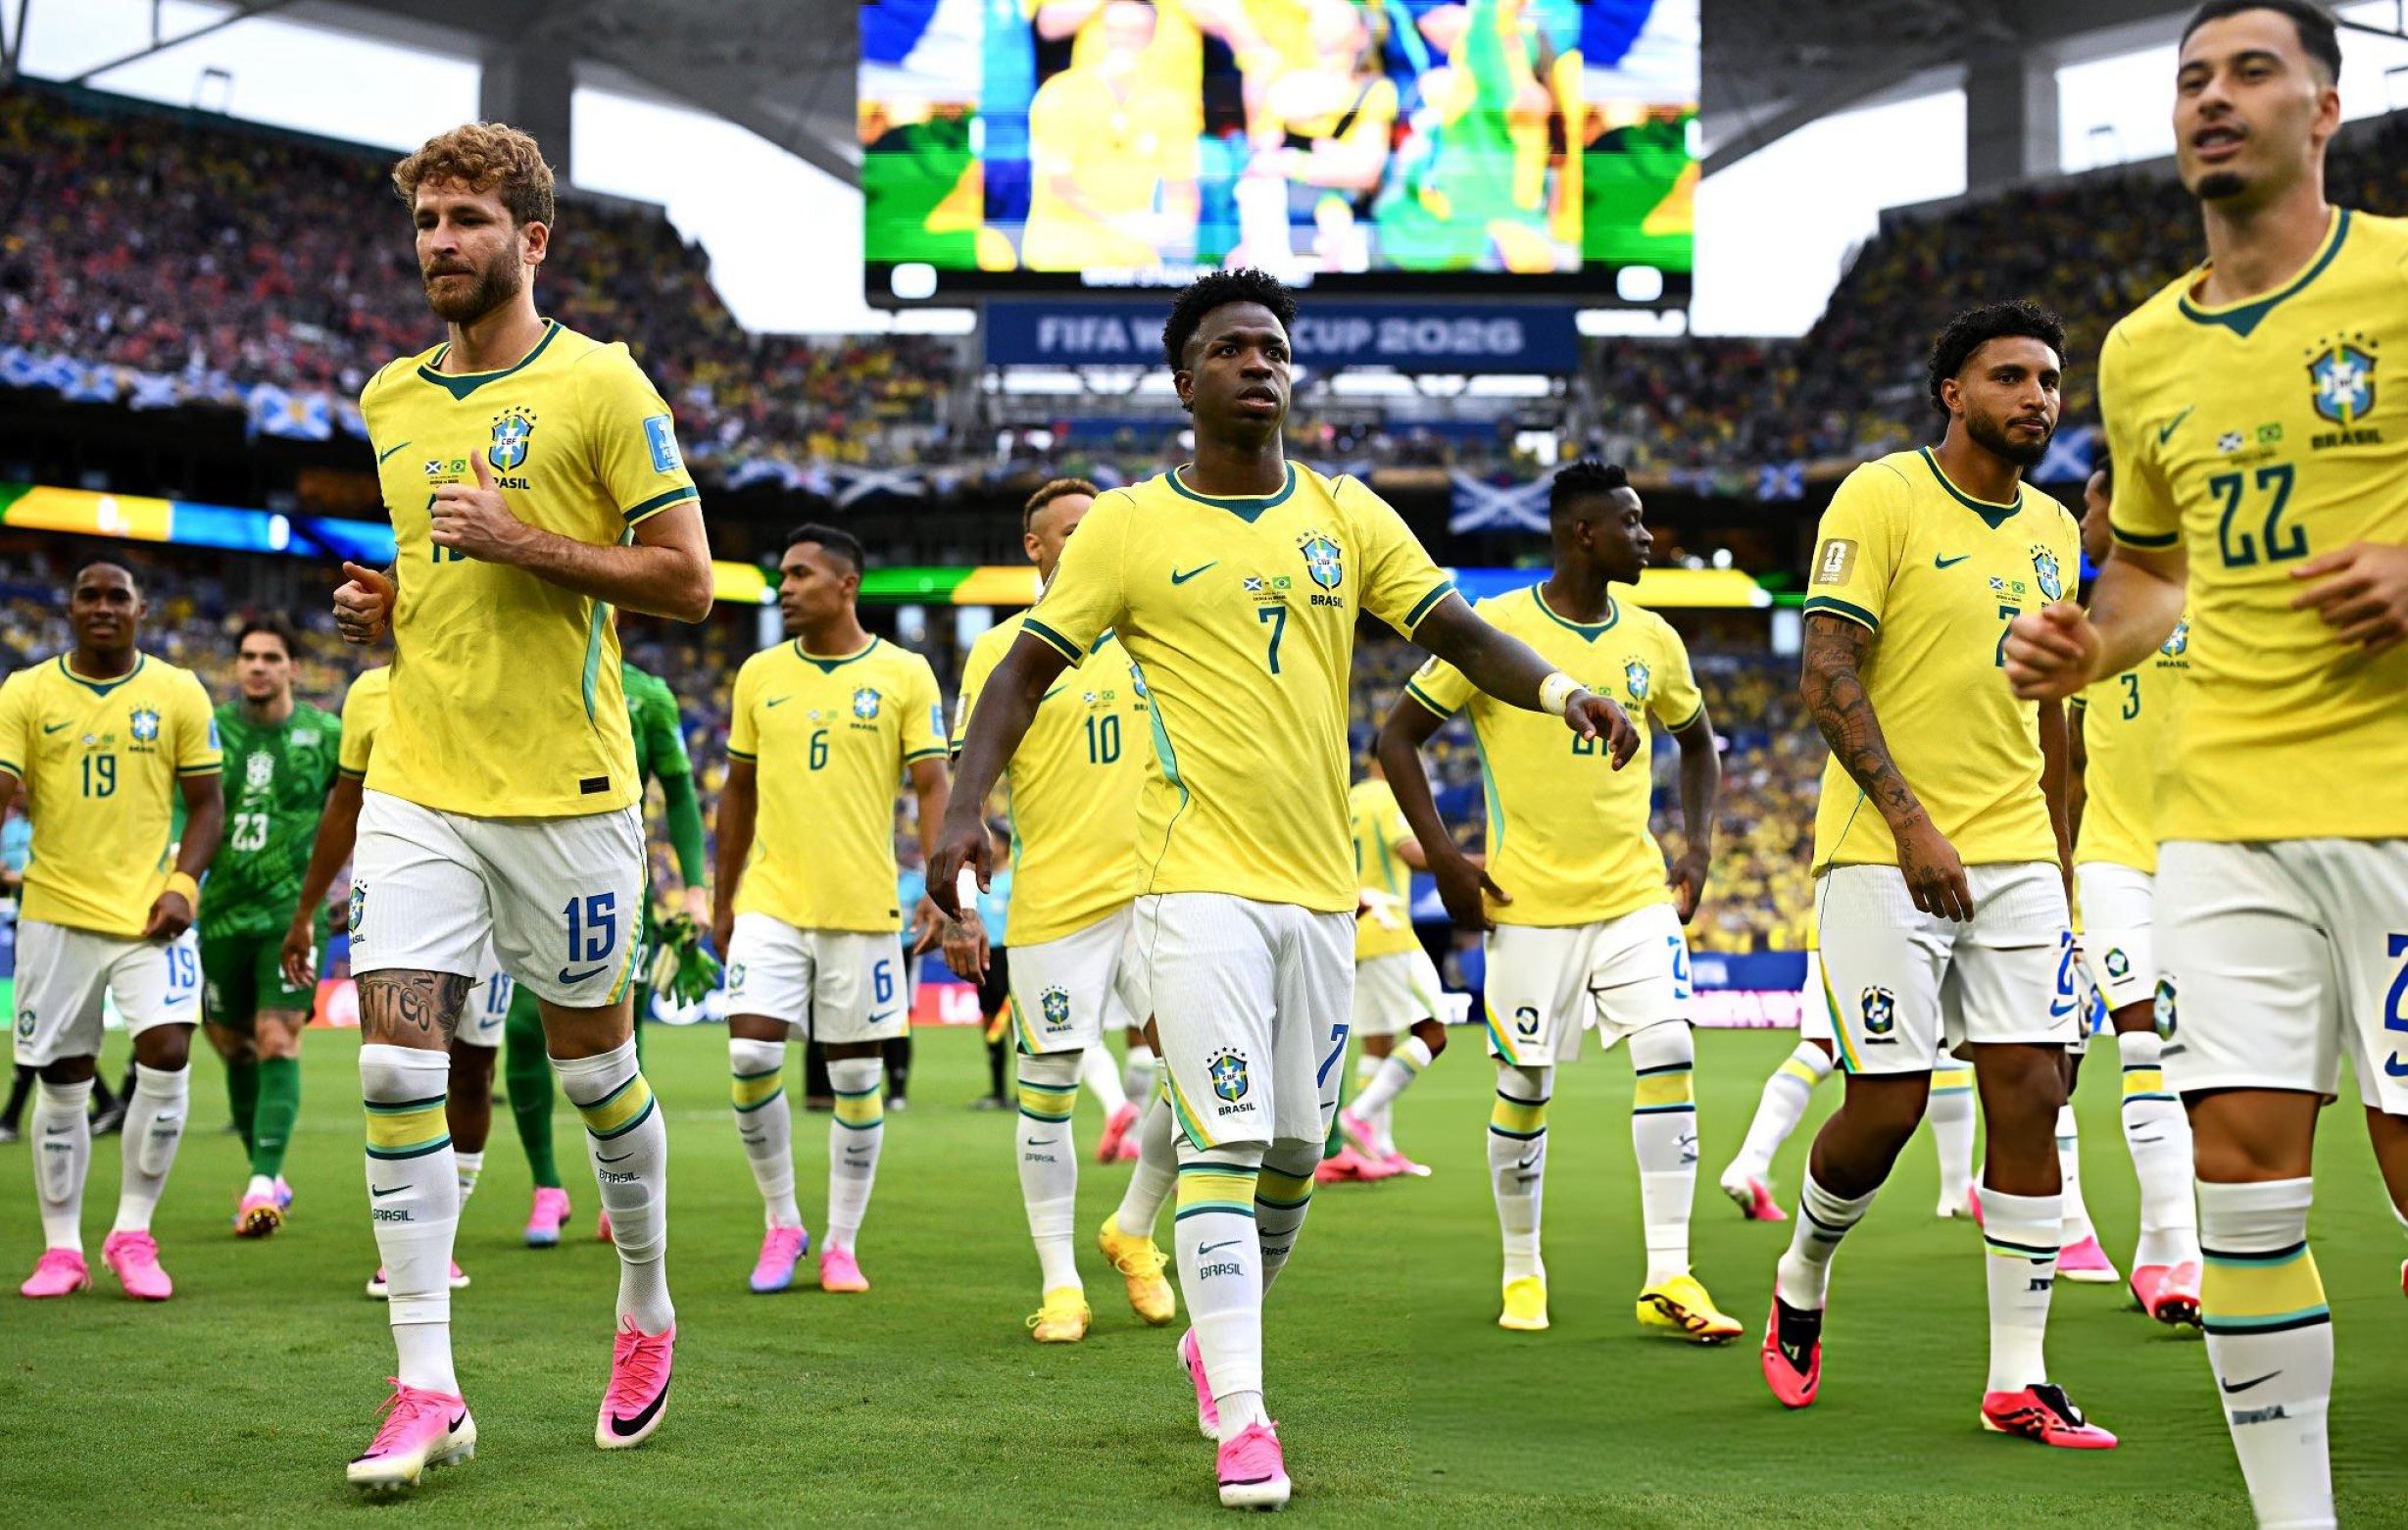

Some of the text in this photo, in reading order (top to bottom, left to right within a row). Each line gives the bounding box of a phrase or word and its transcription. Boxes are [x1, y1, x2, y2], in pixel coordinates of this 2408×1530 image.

[1037, 317, 1129, 352] FIFA
[1290, 318, 1371, 353] CUP
[1377, 318, 1525, 354] 2026
[493, 477, 530, 489] ASIL
[2209, 463, 2309, 568] 22
[1310, 594, 1343, 608] BRASIL
[1258, 606, 1286, 674] 7
[2120, 673, 2141, 720] 3
[810, 728, 828, 770] 6
[1085, 715, 1121, 765] 10
[82, 755, 117, 797] 19
[231, 813, 269, 851] 23
[563, 892, 615, 962] 15
[165, 946, 195, 988] 19
[874, 960, 893, 1004] 6
[487, 972, 512, 1014] 18
[1222, 1072, 1236, 1081] CBF
[1317, 1024, 1349, 1088] 7
[1218, 1103, 1255, 1115] BRASIL
[599, 1168, 640, 1183] BRASIL
[372, 1208, 414, 1221] BRASIL
[1200, 1263, 1244, 1280] BRASIL
